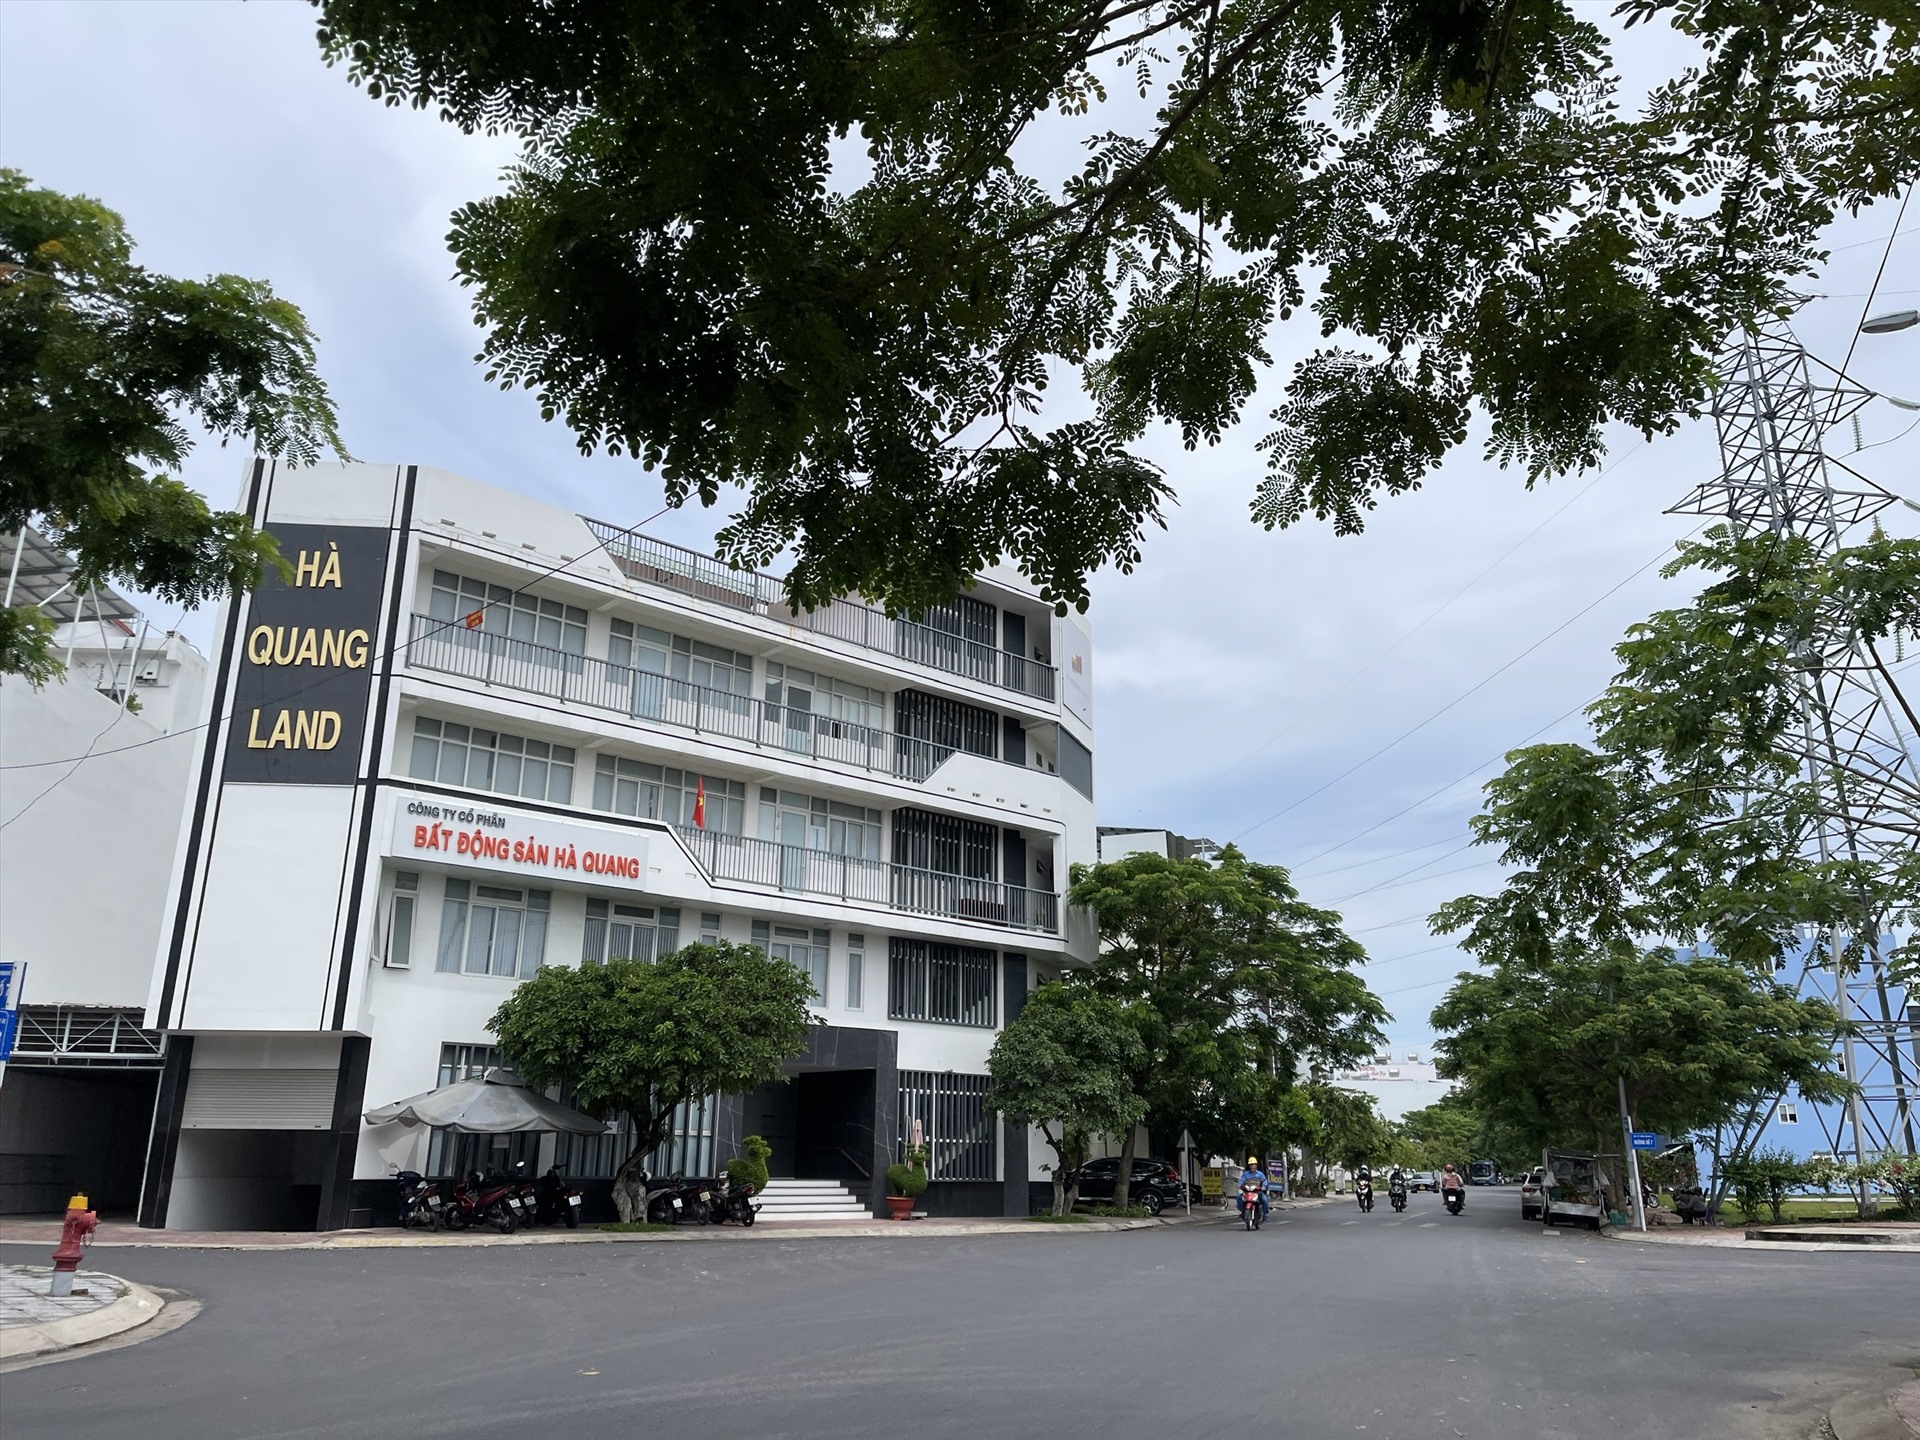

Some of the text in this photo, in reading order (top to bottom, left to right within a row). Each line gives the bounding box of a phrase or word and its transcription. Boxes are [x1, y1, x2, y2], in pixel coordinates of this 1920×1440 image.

[296, 542, 342, 588] HÀ
[248, 625, 369, 669] QUANG
[247, 708, 342, 750] LAND
[408, 802, 506, 829] CÔNG TY CỔ PHẦN
[414, 822, 639, 878] BẤT ĐỘNG SẢN HÀ QUANG
